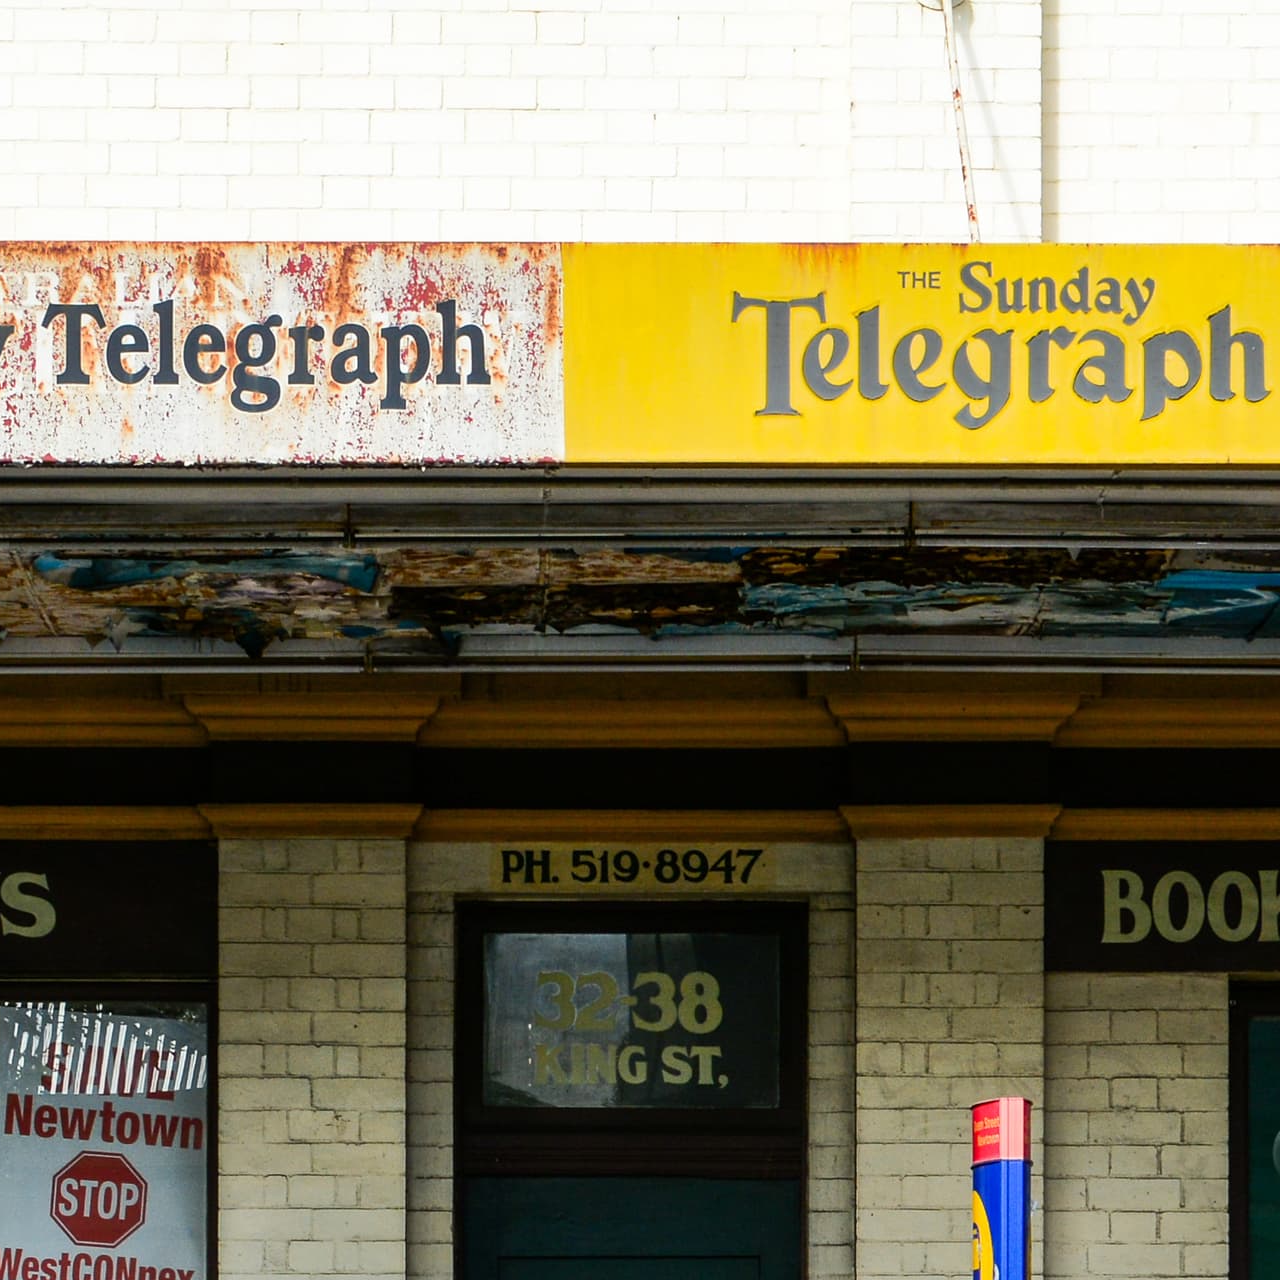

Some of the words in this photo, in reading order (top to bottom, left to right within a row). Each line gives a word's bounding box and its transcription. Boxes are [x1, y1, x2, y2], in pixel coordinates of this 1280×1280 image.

[897, 271, 942, 290] THE
[958, 261, 1156, 324] Sunday
[41, 298, 492, 412] Telegraph
[731, 291, 1271, 430] Telegraph
[501, 849, 559, 884] PH.
[534, 970, 724, 1034] 32-38
[534, 1044, 649, 1086] KING
[3, 1092, 203, 1150] Newtown
[58, 1176, 140, 1221] STOP
